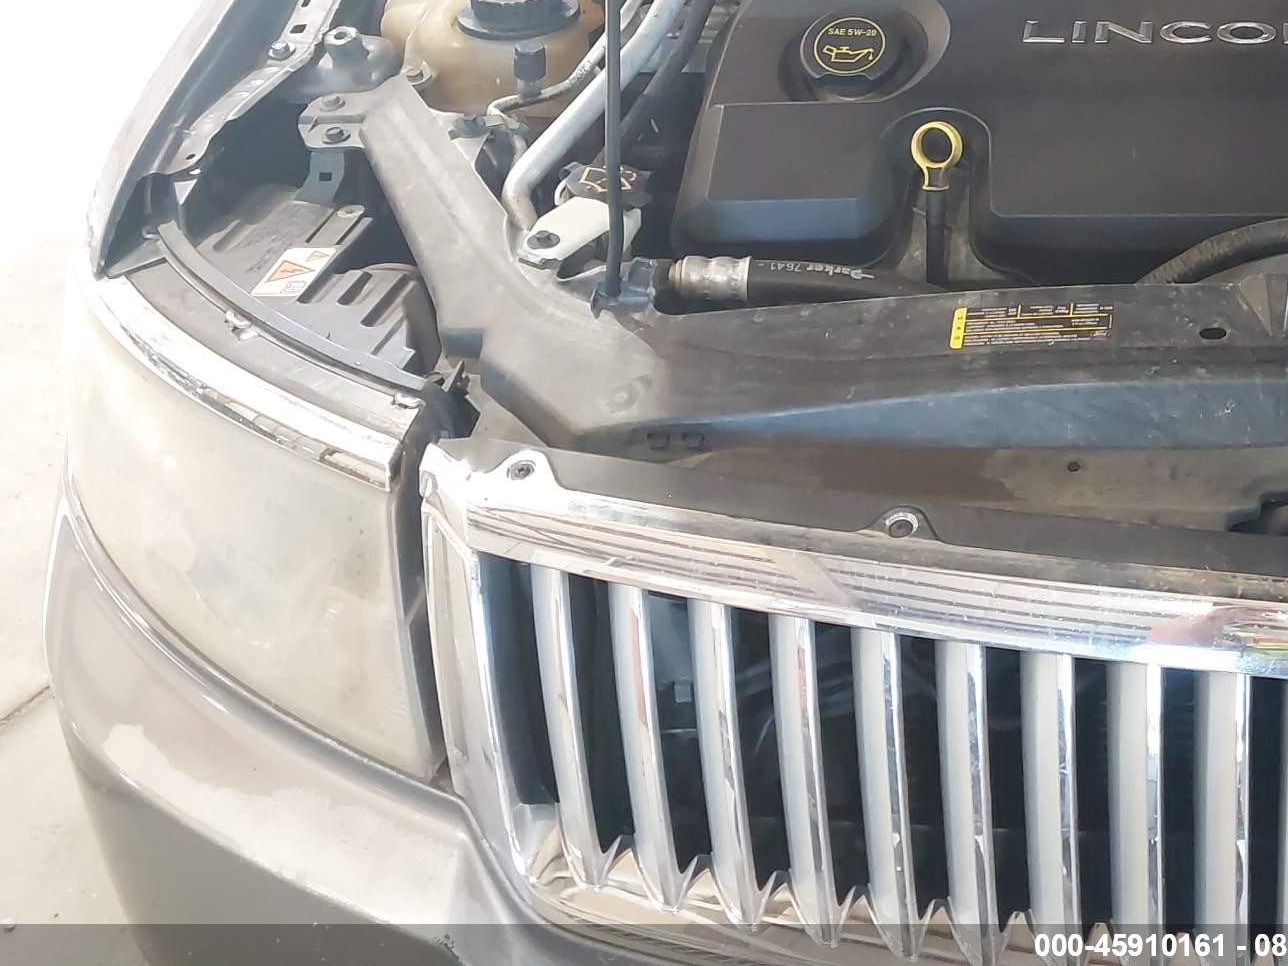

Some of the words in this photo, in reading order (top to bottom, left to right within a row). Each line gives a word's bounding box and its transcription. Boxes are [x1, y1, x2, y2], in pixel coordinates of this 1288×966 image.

[828, 27, 846, 36] SAE
[848, 28, 877, 37] 5W-20
[770, 262, 801, 273] 7641
[805, 264, 875, 279] Parker
